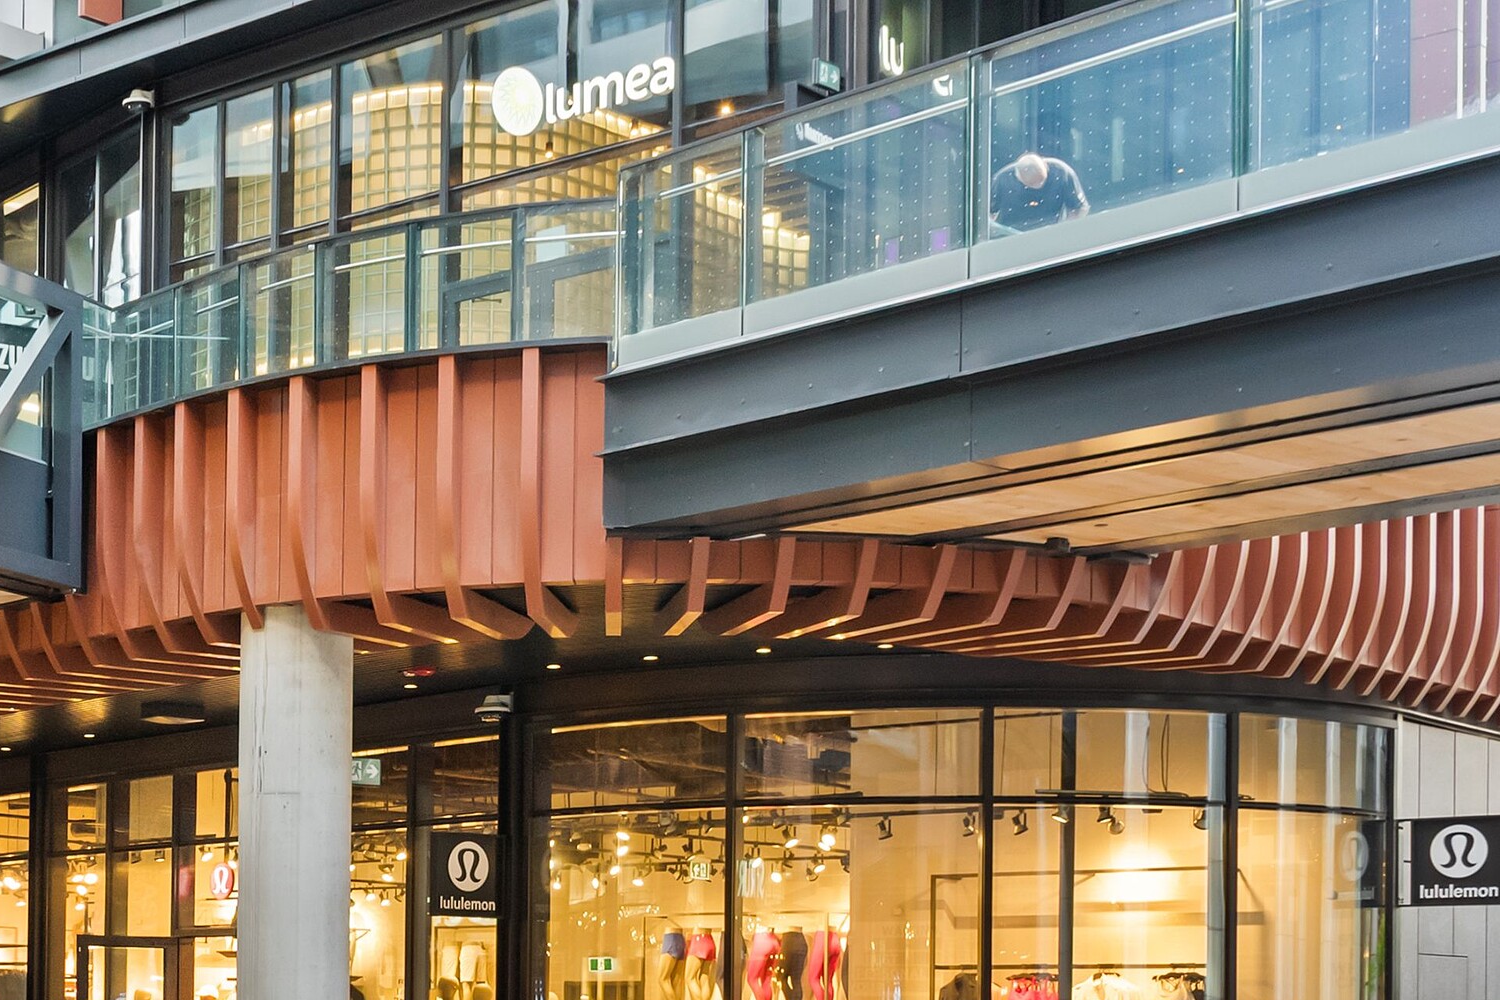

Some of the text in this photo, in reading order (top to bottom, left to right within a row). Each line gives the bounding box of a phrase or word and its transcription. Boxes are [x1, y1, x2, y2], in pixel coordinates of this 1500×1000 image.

[545, 56, 675, 124] lumea
[1419, 884, 1500, 899] lululemon
[440, 895, 496, 912] lululemon
